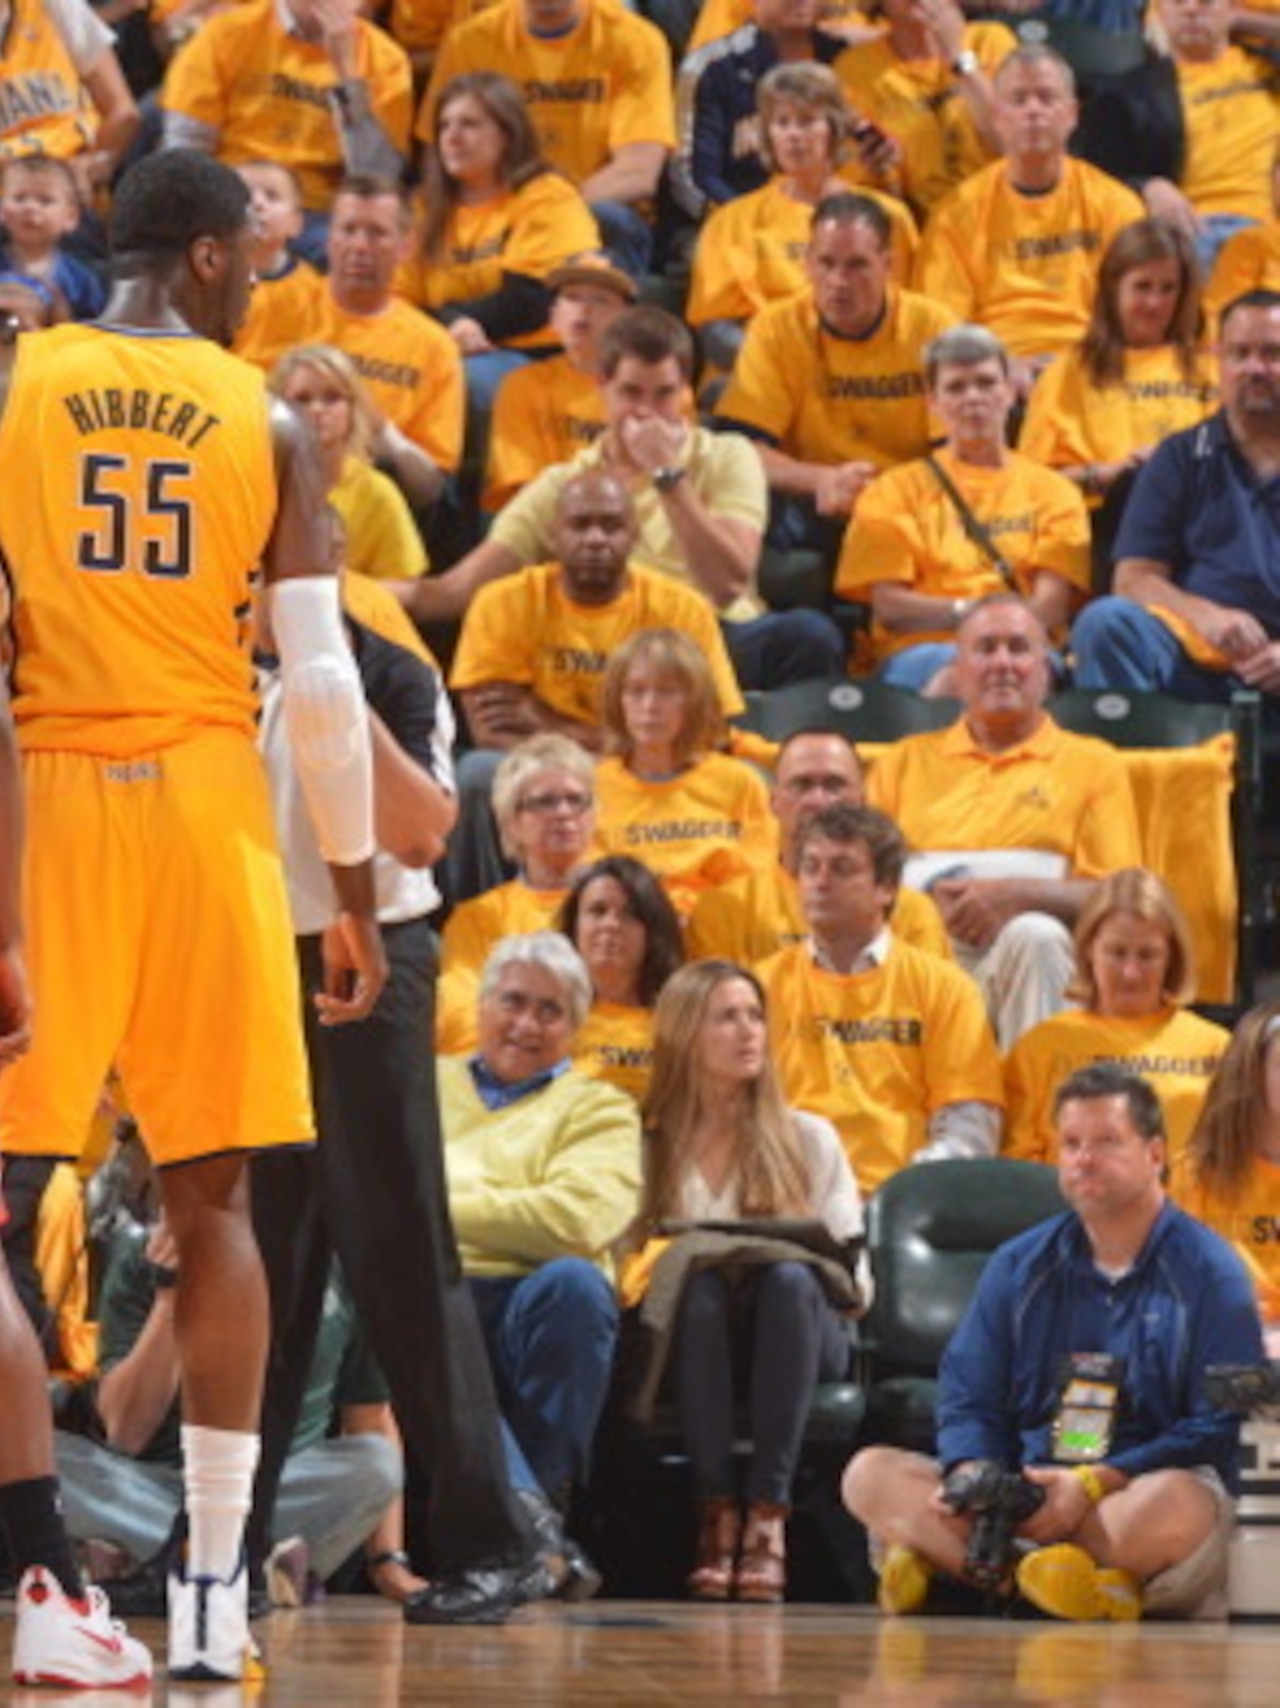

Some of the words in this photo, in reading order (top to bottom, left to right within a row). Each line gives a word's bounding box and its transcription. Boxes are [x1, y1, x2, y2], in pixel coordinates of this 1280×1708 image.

[63, 388, 221, 449] HIBBERT
[78, 453, 191, 578] 55
[624, 820, 742, 846] SWAGGER
